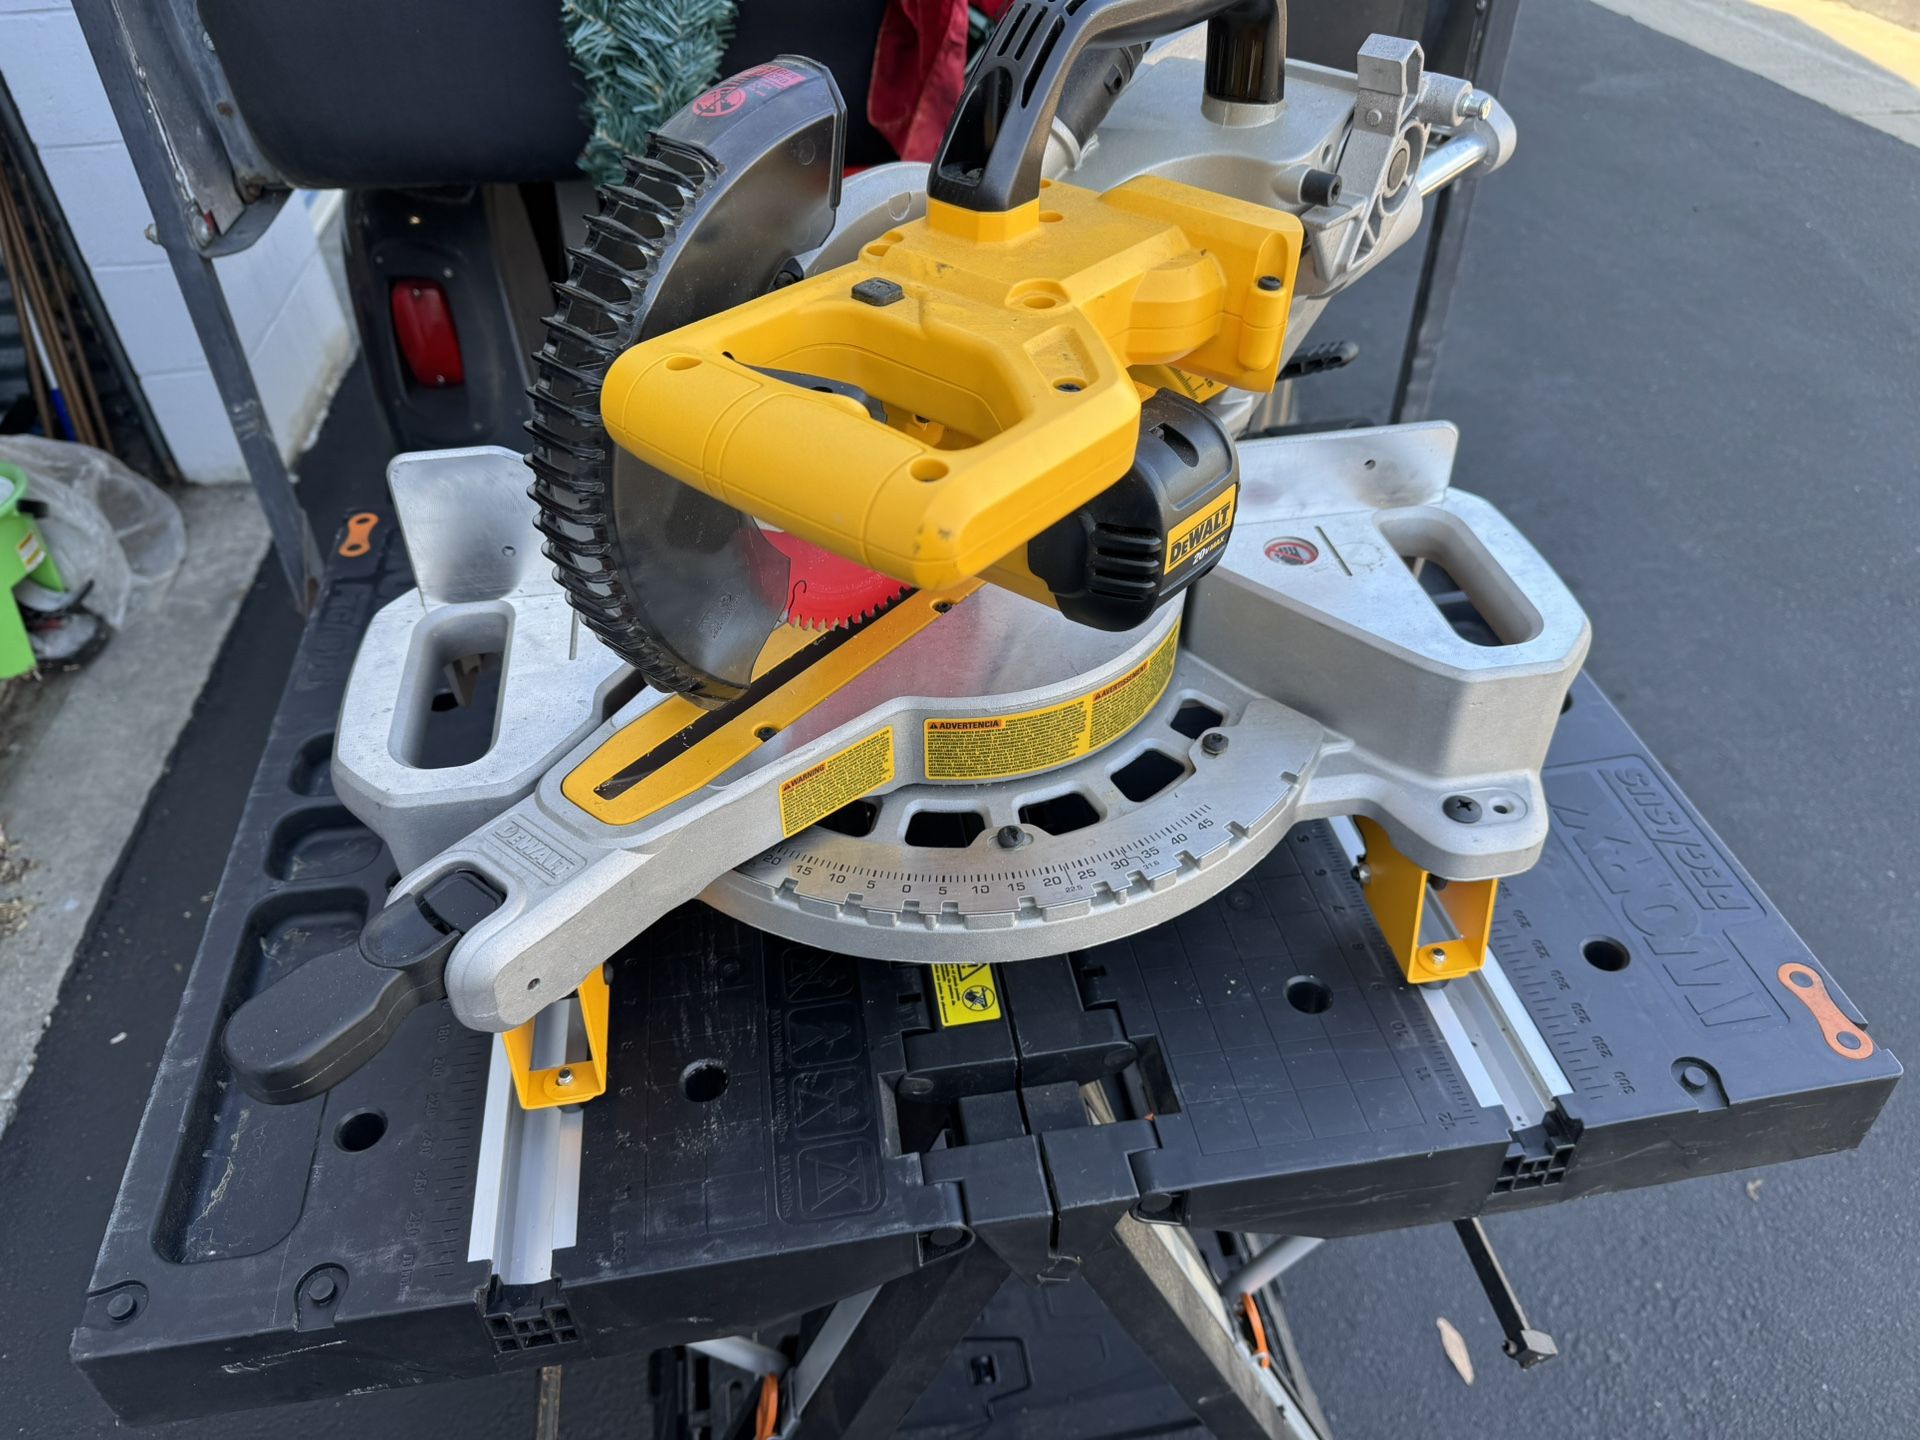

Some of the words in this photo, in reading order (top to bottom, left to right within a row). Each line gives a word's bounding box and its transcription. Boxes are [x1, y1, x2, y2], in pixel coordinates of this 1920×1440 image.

[1168, 503, 1231, 565] DEWALT
[940, 719, 1000, 731] ADVERTENCIA
[791, 762, 827, 787] WARNING
[494, 823, 574, 879] DEWALT
[763, 854, 782, 866] 20
[796, 864, 813, 876] 15
[828, 873, 846, 885] 10
[866, 879, 876, 889] 5
[901, 884, 912, 894] 0
[938, 886, 948, 895] 5
[971, 884, 990, 895] 10
[1007, 881, 1026, 892] 15
[1042, 875, 1062, 887] 20
[1077, 867, 1097, 880] 25
[1110, 858, 1130, 870] 30
[1140, 846, 1160, 859] 35
[1171, 833, 1188, 845] 40
[1197, 818, 1214, 830] 45
